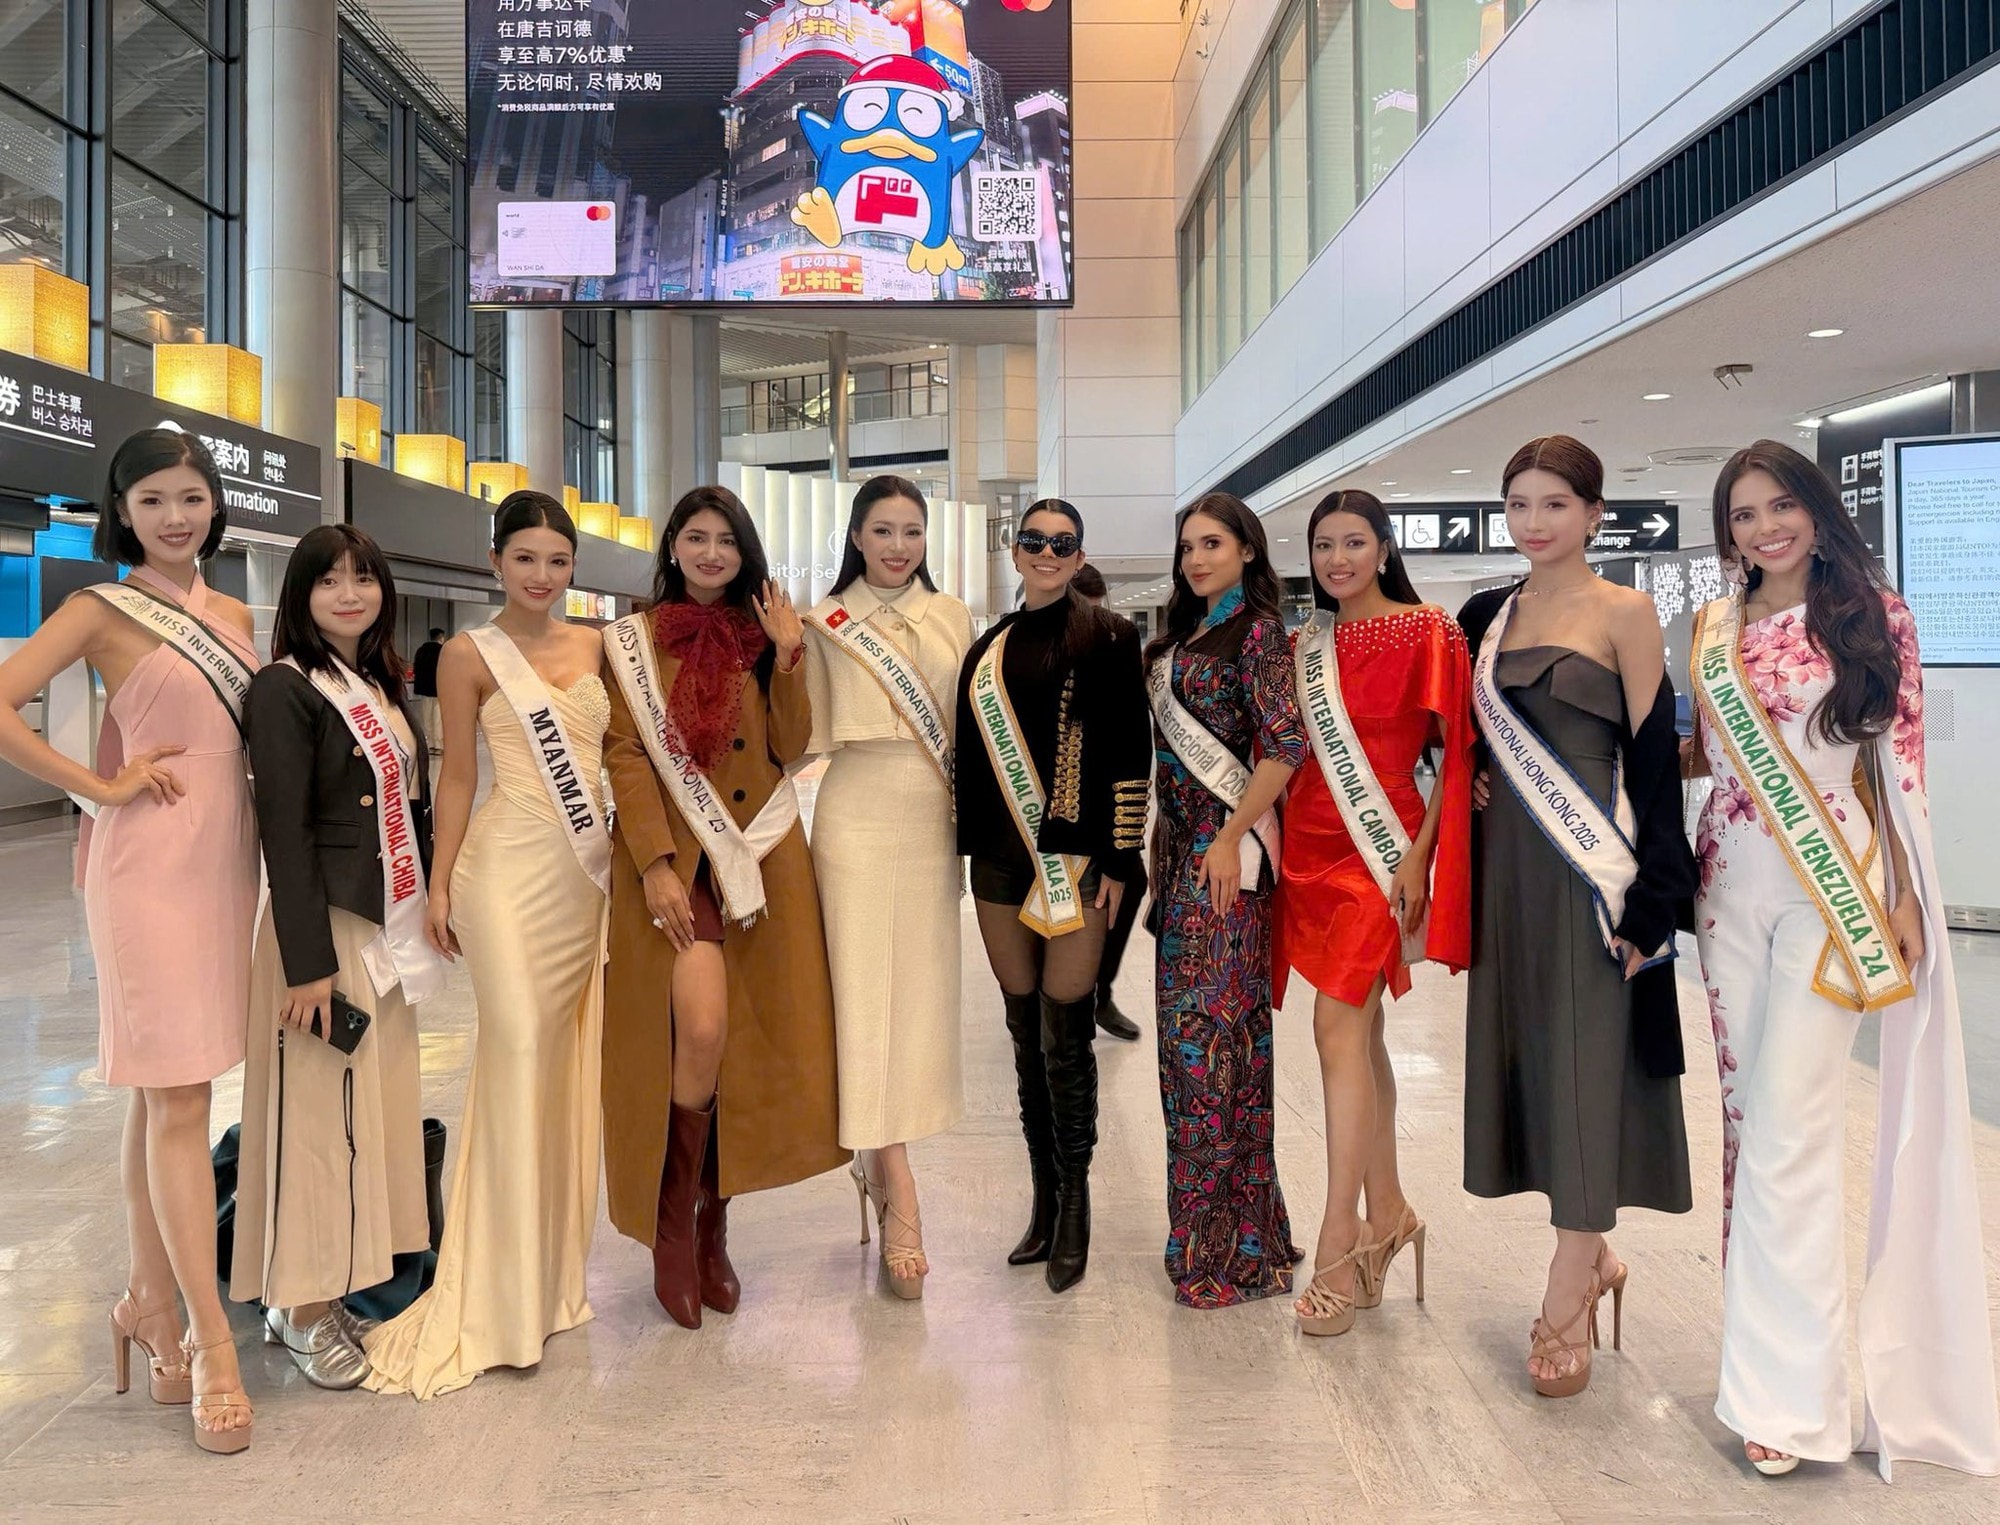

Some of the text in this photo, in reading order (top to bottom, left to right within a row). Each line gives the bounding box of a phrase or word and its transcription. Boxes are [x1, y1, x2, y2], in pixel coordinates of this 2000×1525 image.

[497, 20, 592, 39] 在唐吉诃德
[944, 64, 970, 88] 50m
[32, 384, 82, 414] 巴士车票
[32, 406, 93, 437] 버스 승차권
[1927, 479, 1960, 487] Travelers
[151, 611, 189, 637] MISS
[614, 620, 639, 651] MISS
[977, 662, 992, 691] MISS
[1304, 649, 1322, 683] MISS
[1703, 643, 1728, 681] MISS
[854, 631, 884, 657] MISS
[880, 655, 944, 751] INTERNATIONAL
[979, 692, 1034, 802] INTERNATIONAL
[1160, 699, 1222, 775] ternacional
[1307, 683, 1365, 808] INTERNATIONAL
[529, 707, 594, 834] MYANMAR
[1473, 676, 1529, 763] INTERNATIONAL
[1520, 756, 1555, 794] HONG
[1546, 791, 1577, 829] KONG
[1571, 820, 1600, 851] 2025
[1711, 681, 1807, 832] INTERNATIONAL
[349, 703, 416, 904] MISS INTERNATIONAL CHIBA
[1048, 887, 1072, 904] 2025
[1796, 829, 1873, 945] VENEZUELA
